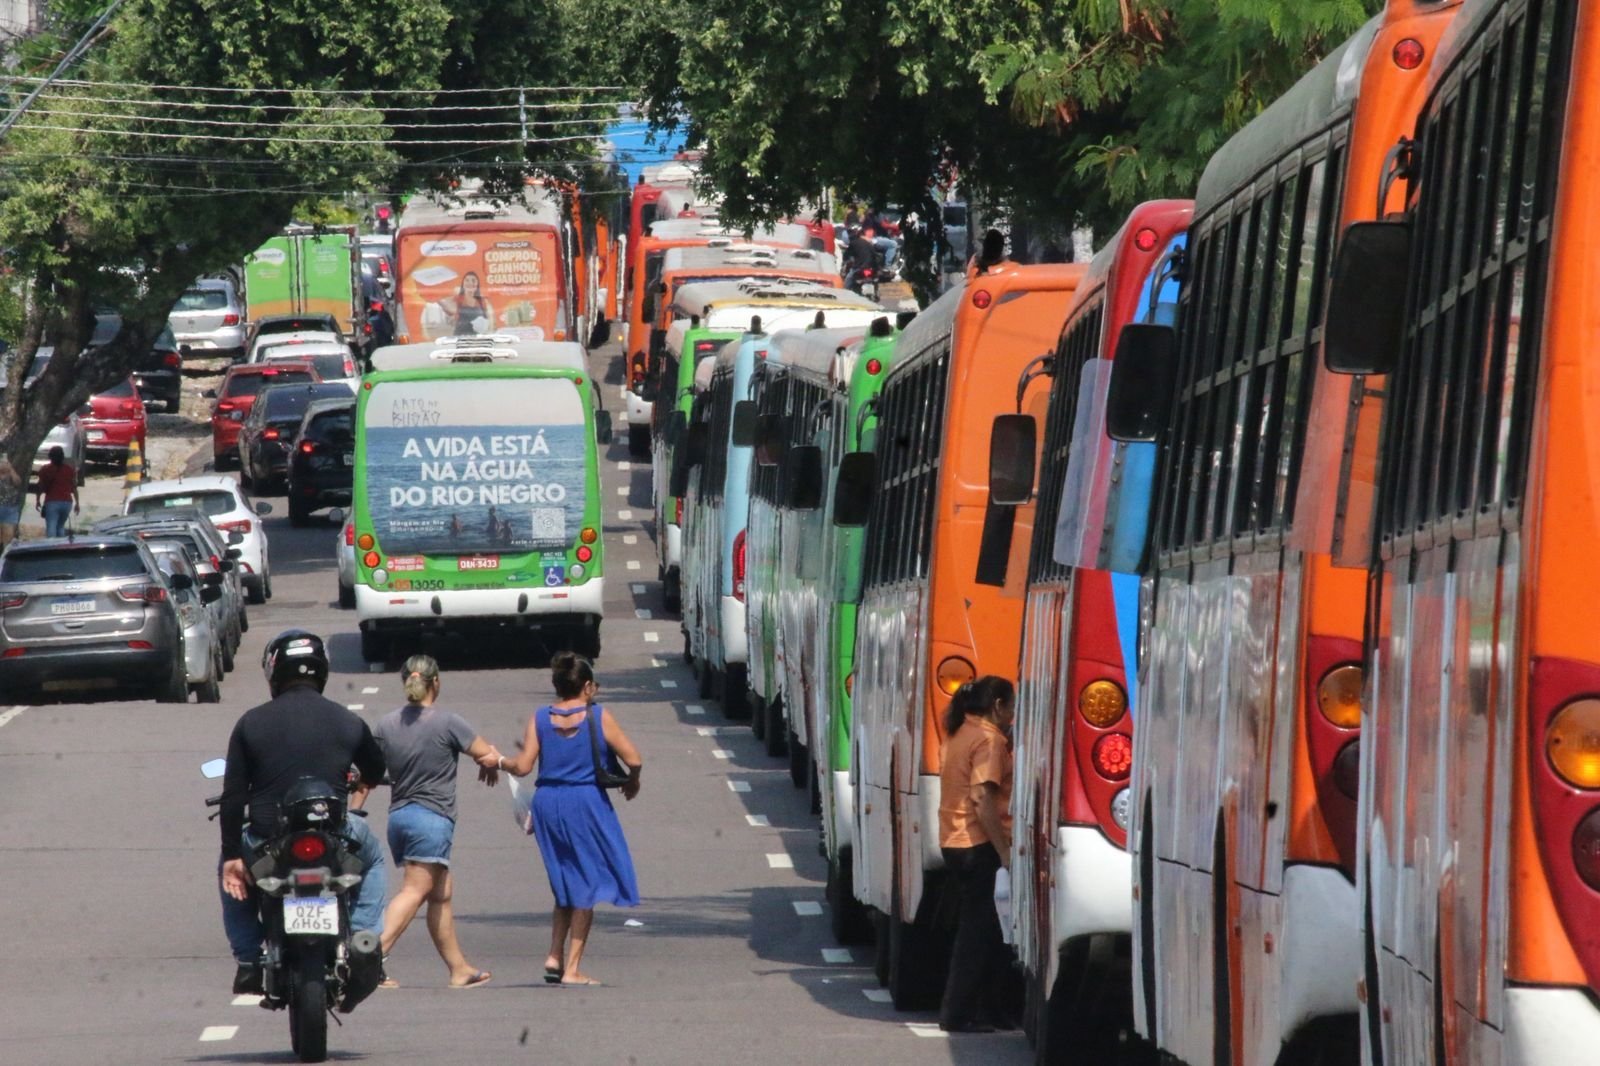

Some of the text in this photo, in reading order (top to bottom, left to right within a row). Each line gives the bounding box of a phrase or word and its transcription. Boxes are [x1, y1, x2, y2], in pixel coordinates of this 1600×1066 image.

[402, 428, 550, 458] A VIDA ESTÁ
[421, 455, 534, 481] NA ÁGUA
[390, 483, 566, 507] DO RIO NEGRO
[296, 905, 326, 918] QZF
